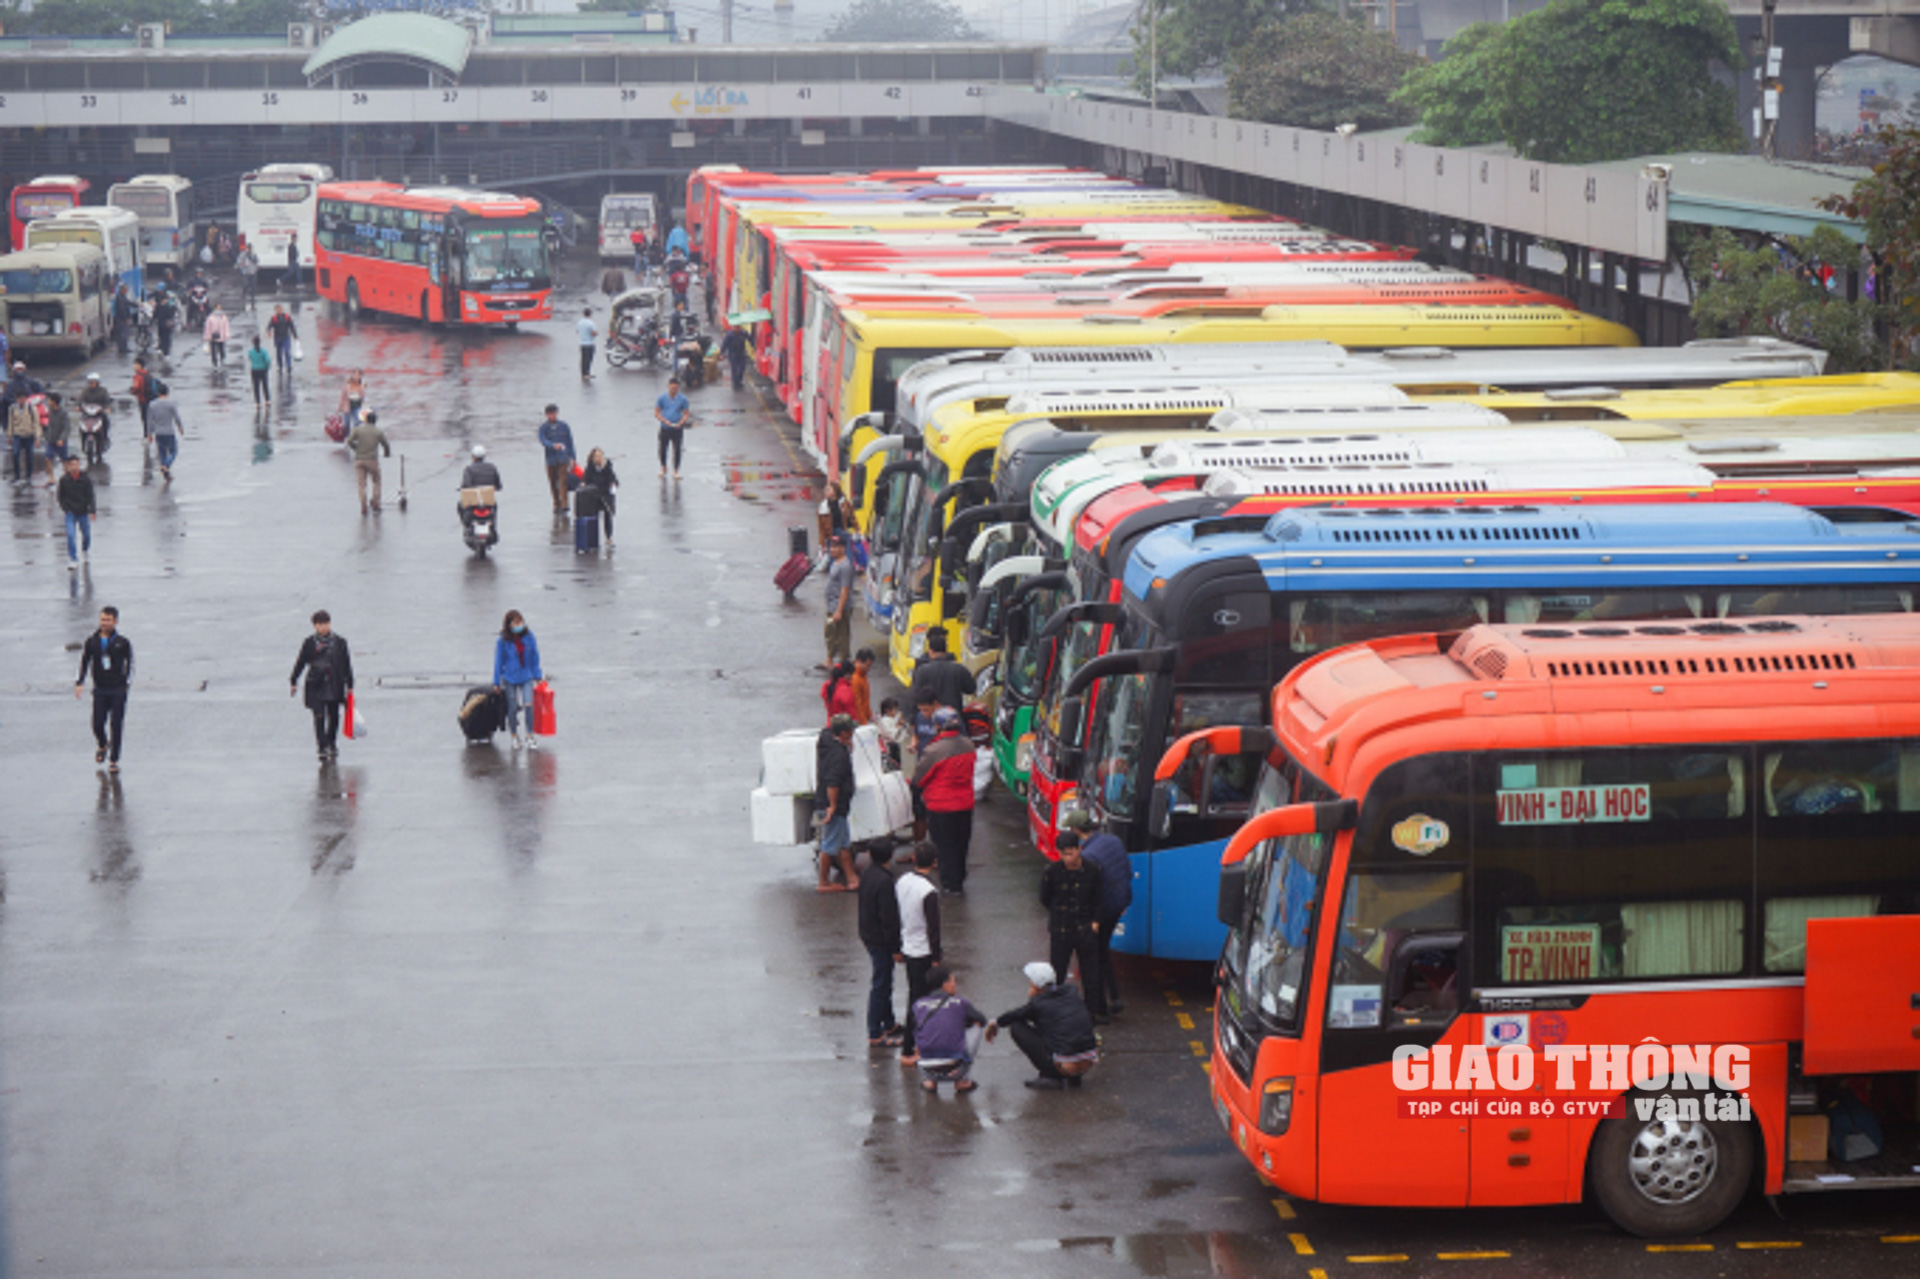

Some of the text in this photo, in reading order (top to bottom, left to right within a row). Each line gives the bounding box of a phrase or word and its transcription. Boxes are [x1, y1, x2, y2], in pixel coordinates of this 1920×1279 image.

[725, 90, 749, 105] RA
[883, 87, 902, 99] 42
[81, 95, 97, 108] 33
[1497, 792, 1545, 823] VINH
[1560, 790, 1596, 823] ĐẠI
[1604, 787, 1647, 822] HỌC
